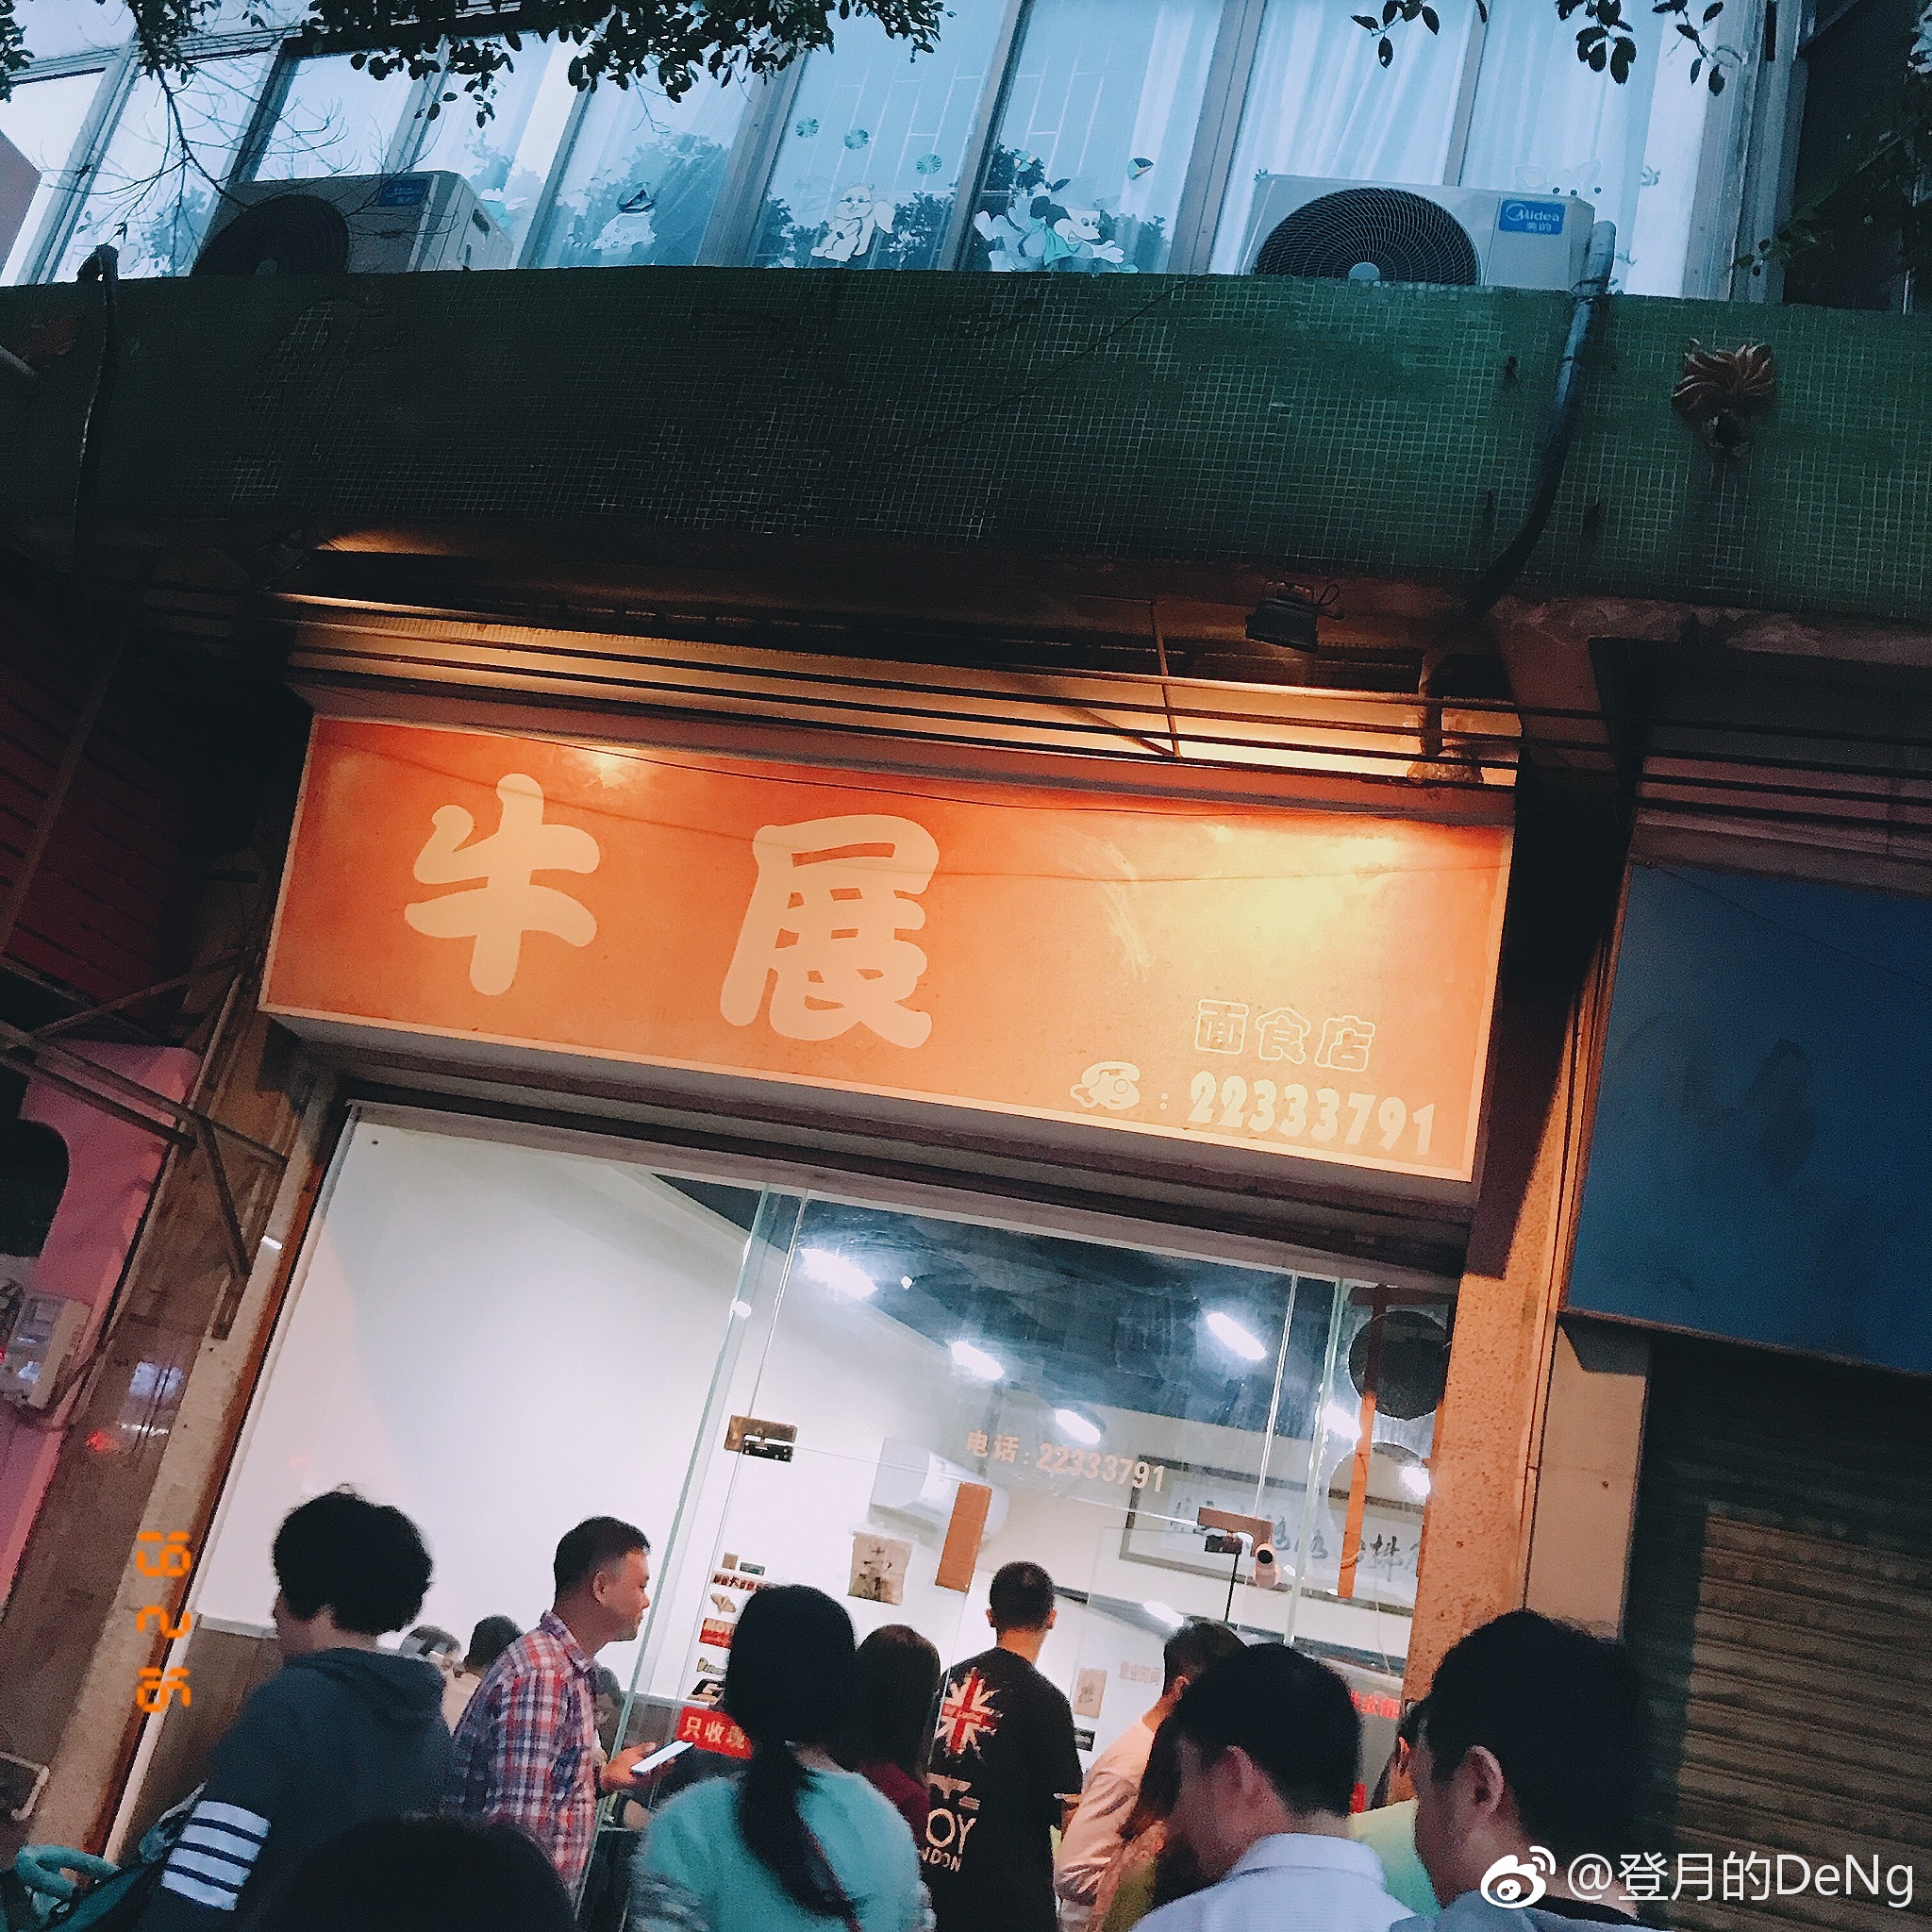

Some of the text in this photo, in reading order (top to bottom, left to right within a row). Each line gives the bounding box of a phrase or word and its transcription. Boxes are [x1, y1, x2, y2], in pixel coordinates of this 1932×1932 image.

[1506, 202, 1560, 223] Midea
[404, 772, 941, 1050] 牛展
[1194, 997, 1376, 1074] 面食店
[1188, 1071, 1436, 1157] 22333791
[920, 1846, 963, 1873] NDON
[926, 1807, 977, 1855] OY
